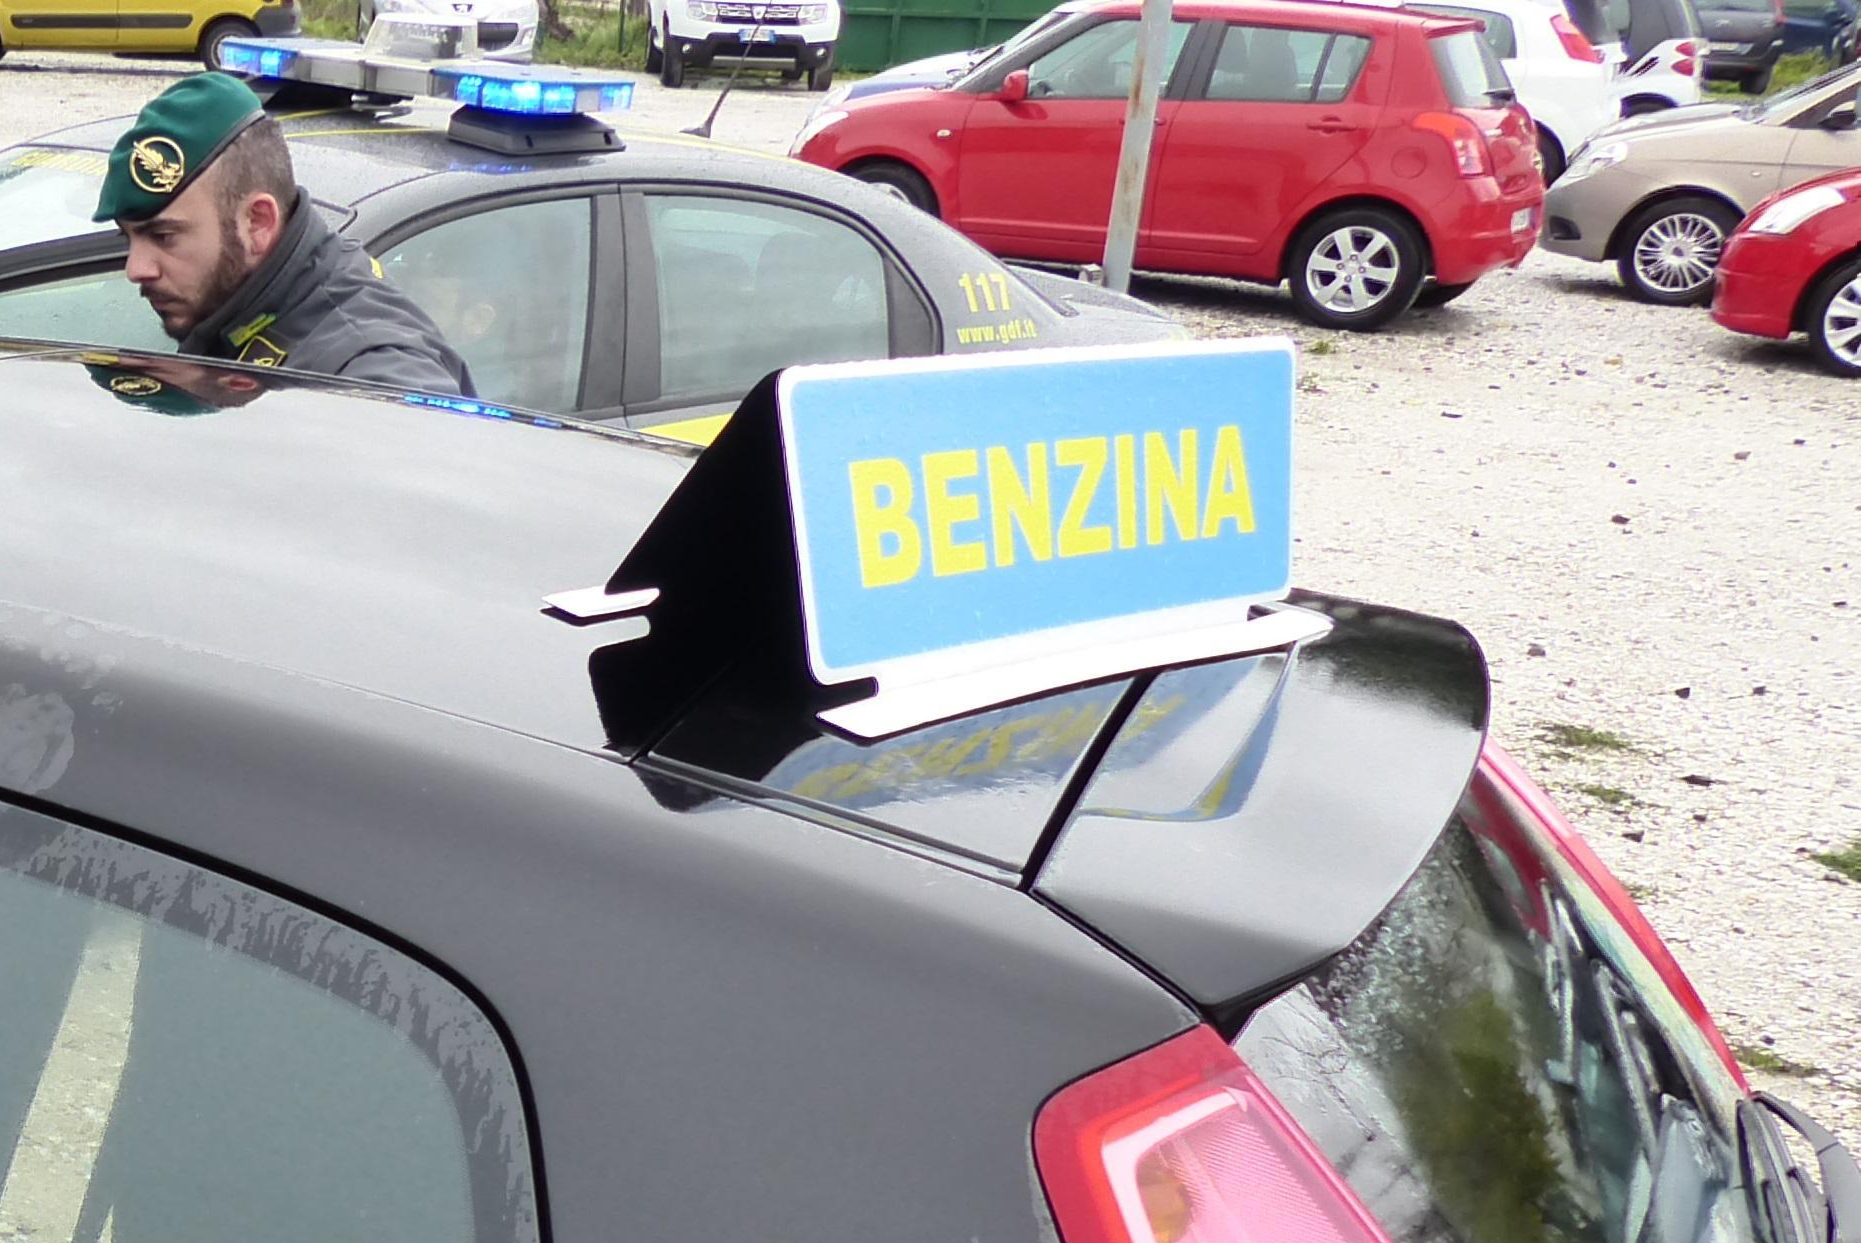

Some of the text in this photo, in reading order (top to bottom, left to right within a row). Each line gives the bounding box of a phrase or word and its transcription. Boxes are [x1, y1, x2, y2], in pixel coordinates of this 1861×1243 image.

[958, 272, 1011, 313] 117
[957, 319, 1038, 344] www.gdf.it
[848, 424, 1256, 589] BENZINA
